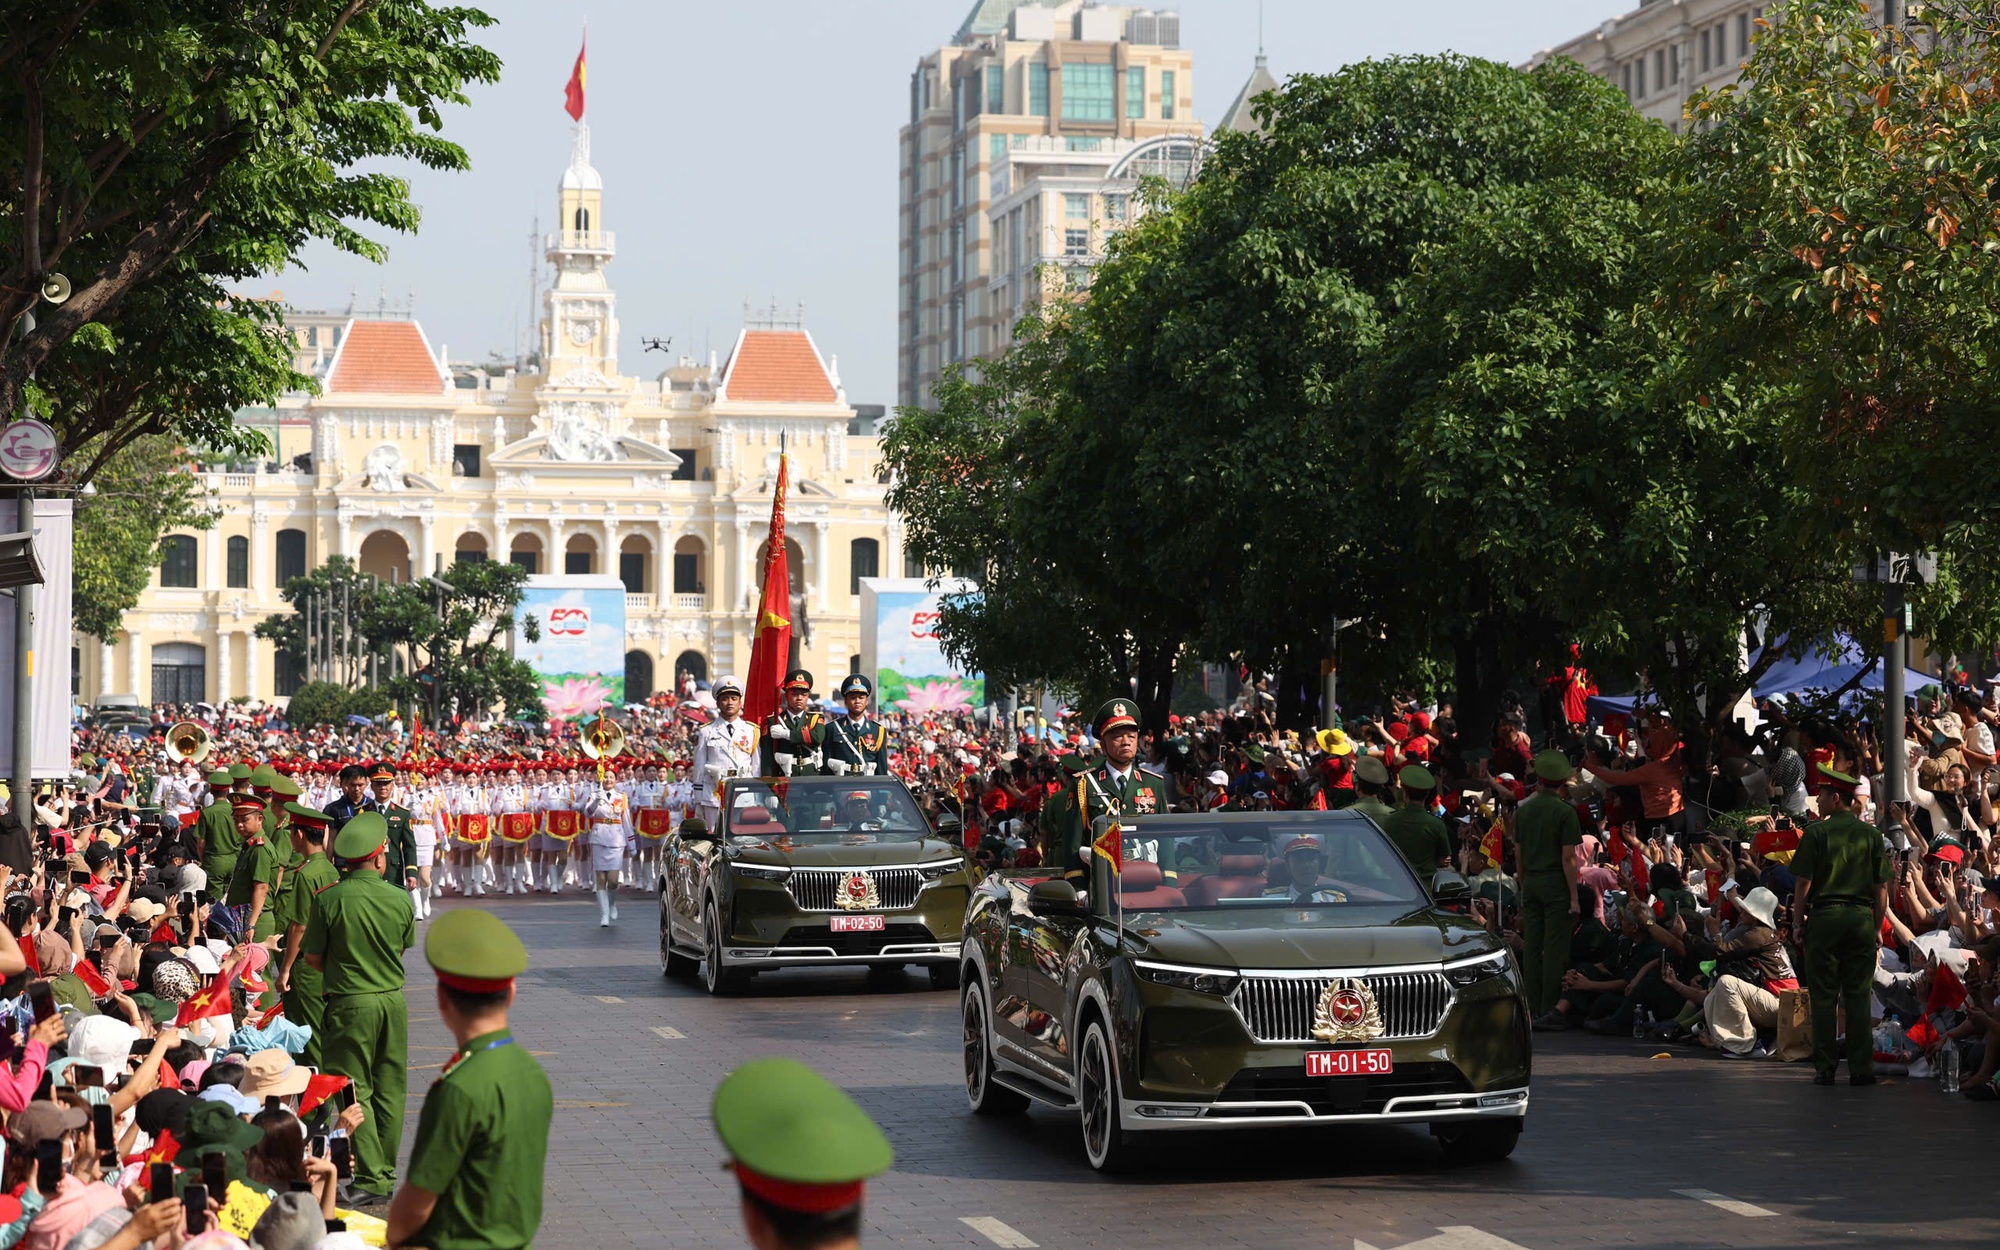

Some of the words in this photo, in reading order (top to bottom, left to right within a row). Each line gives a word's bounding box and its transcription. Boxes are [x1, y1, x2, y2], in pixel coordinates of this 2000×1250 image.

[549, 609, 589, 635] 50
[832, 917, 883, 930] TM-02-50
[1309, 1052, 1389, 1074] TM-01-50
